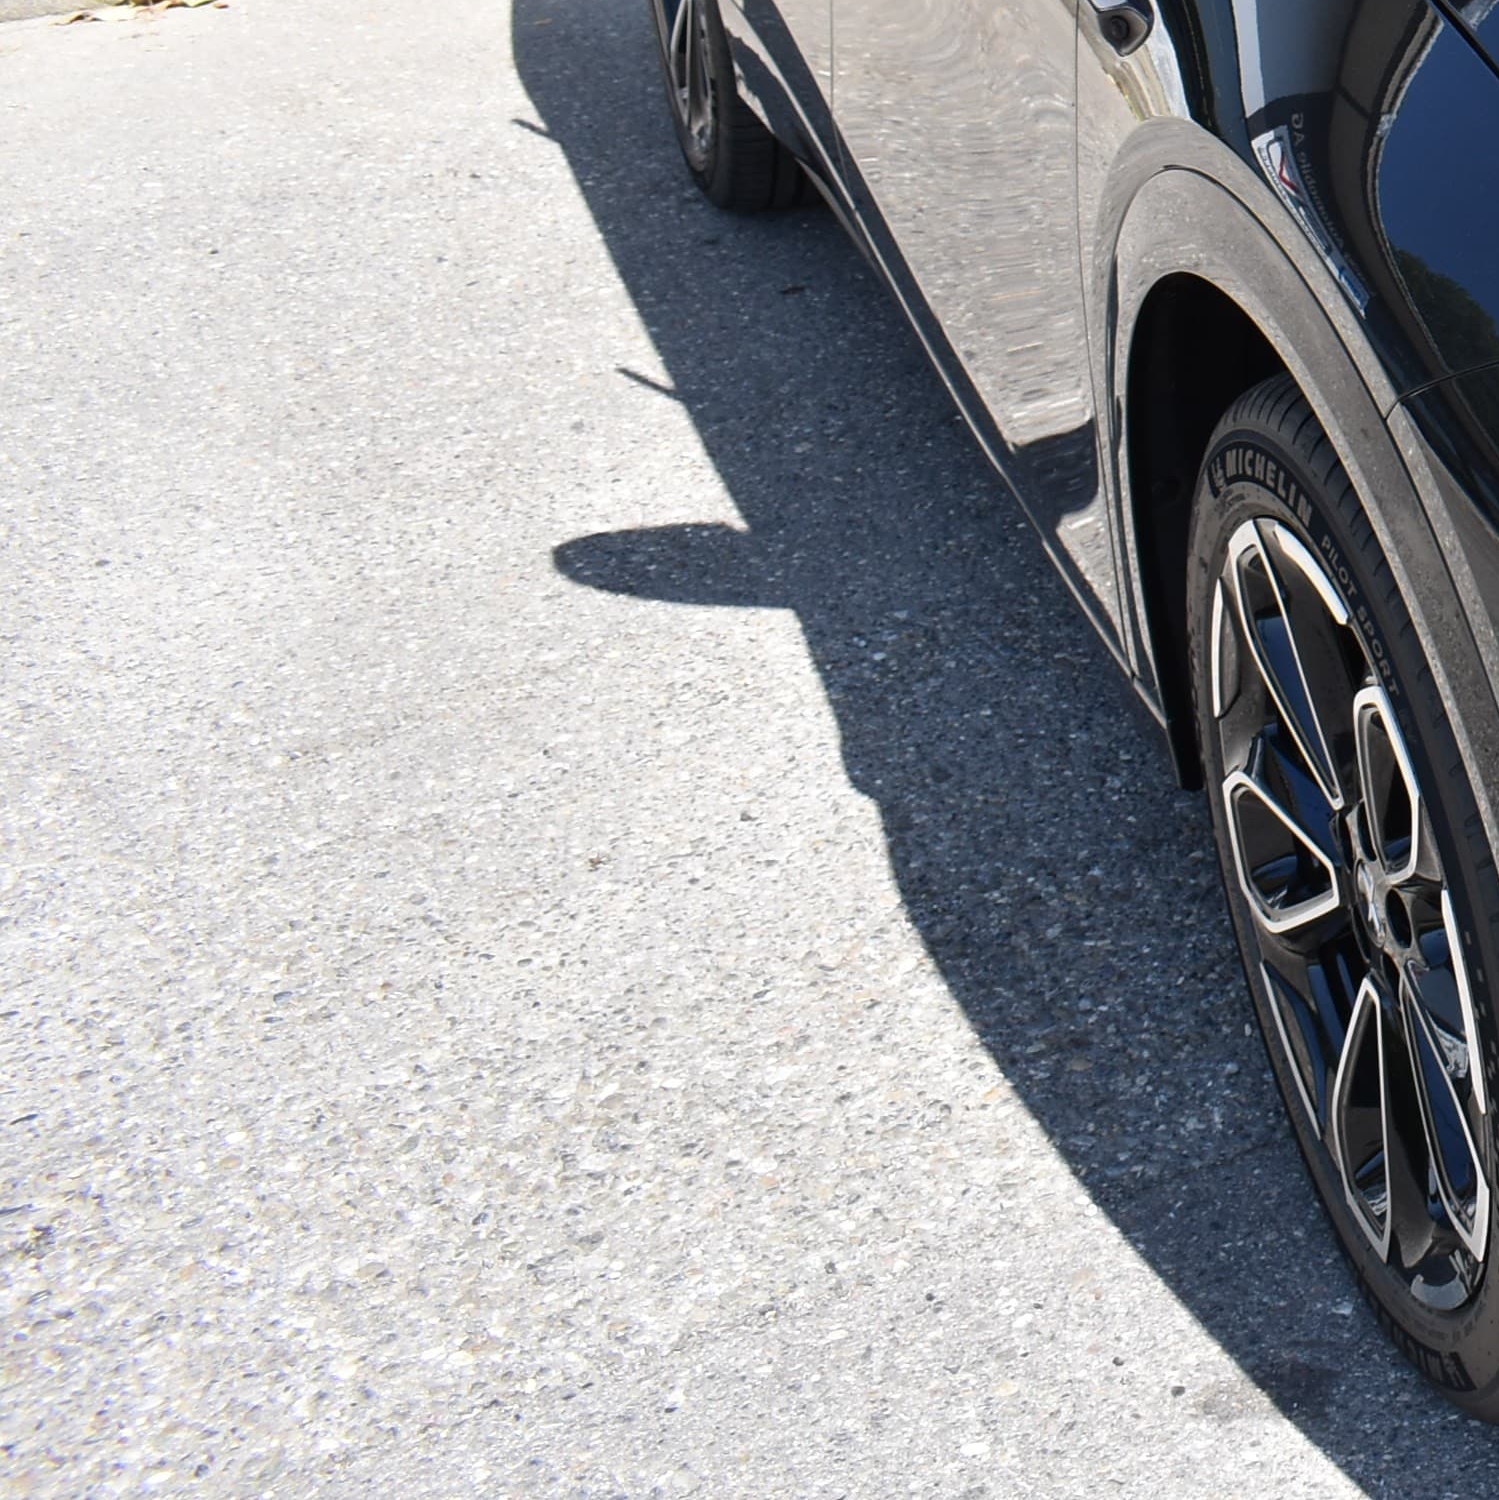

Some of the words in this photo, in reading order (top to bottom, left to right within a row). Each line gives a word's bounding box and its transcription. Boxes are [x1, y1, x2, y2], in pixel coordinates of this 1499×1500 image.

[1225, 448, 1312, 527] MICHELIN
[1321, 536, 1356, 594] PILOT
[1356, 605, 1399, 695] SPORT
